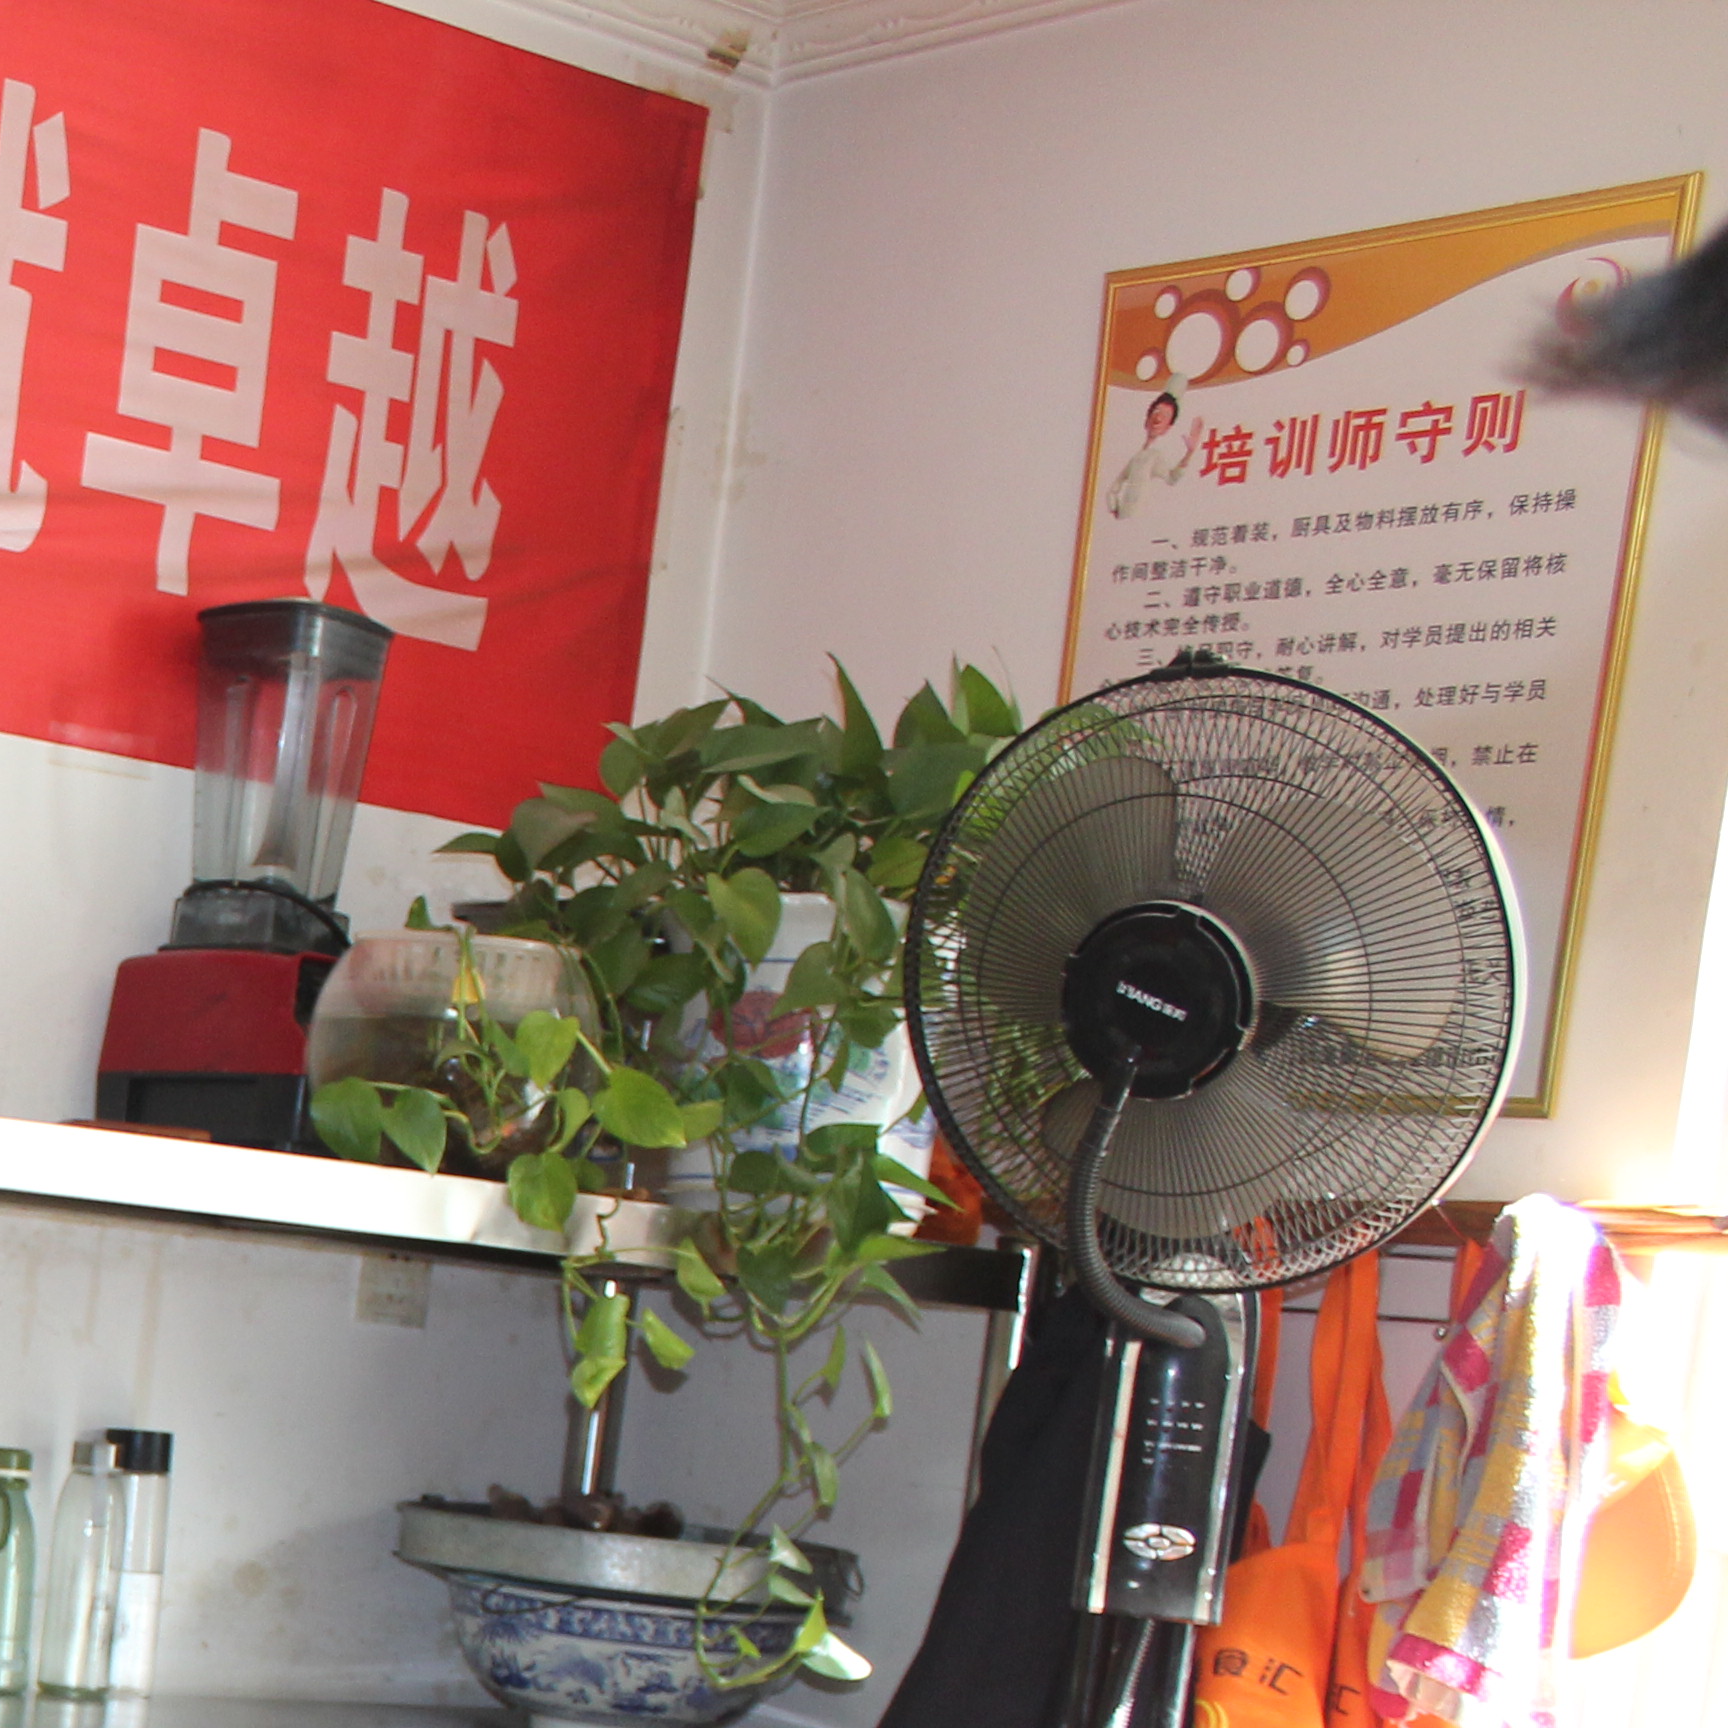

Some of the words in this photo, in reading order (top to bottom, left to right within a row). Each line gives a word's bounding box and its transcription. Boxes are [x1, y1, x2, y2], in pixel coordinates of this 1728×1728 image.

[1198, 389, 1526, 487] 培训师守则
